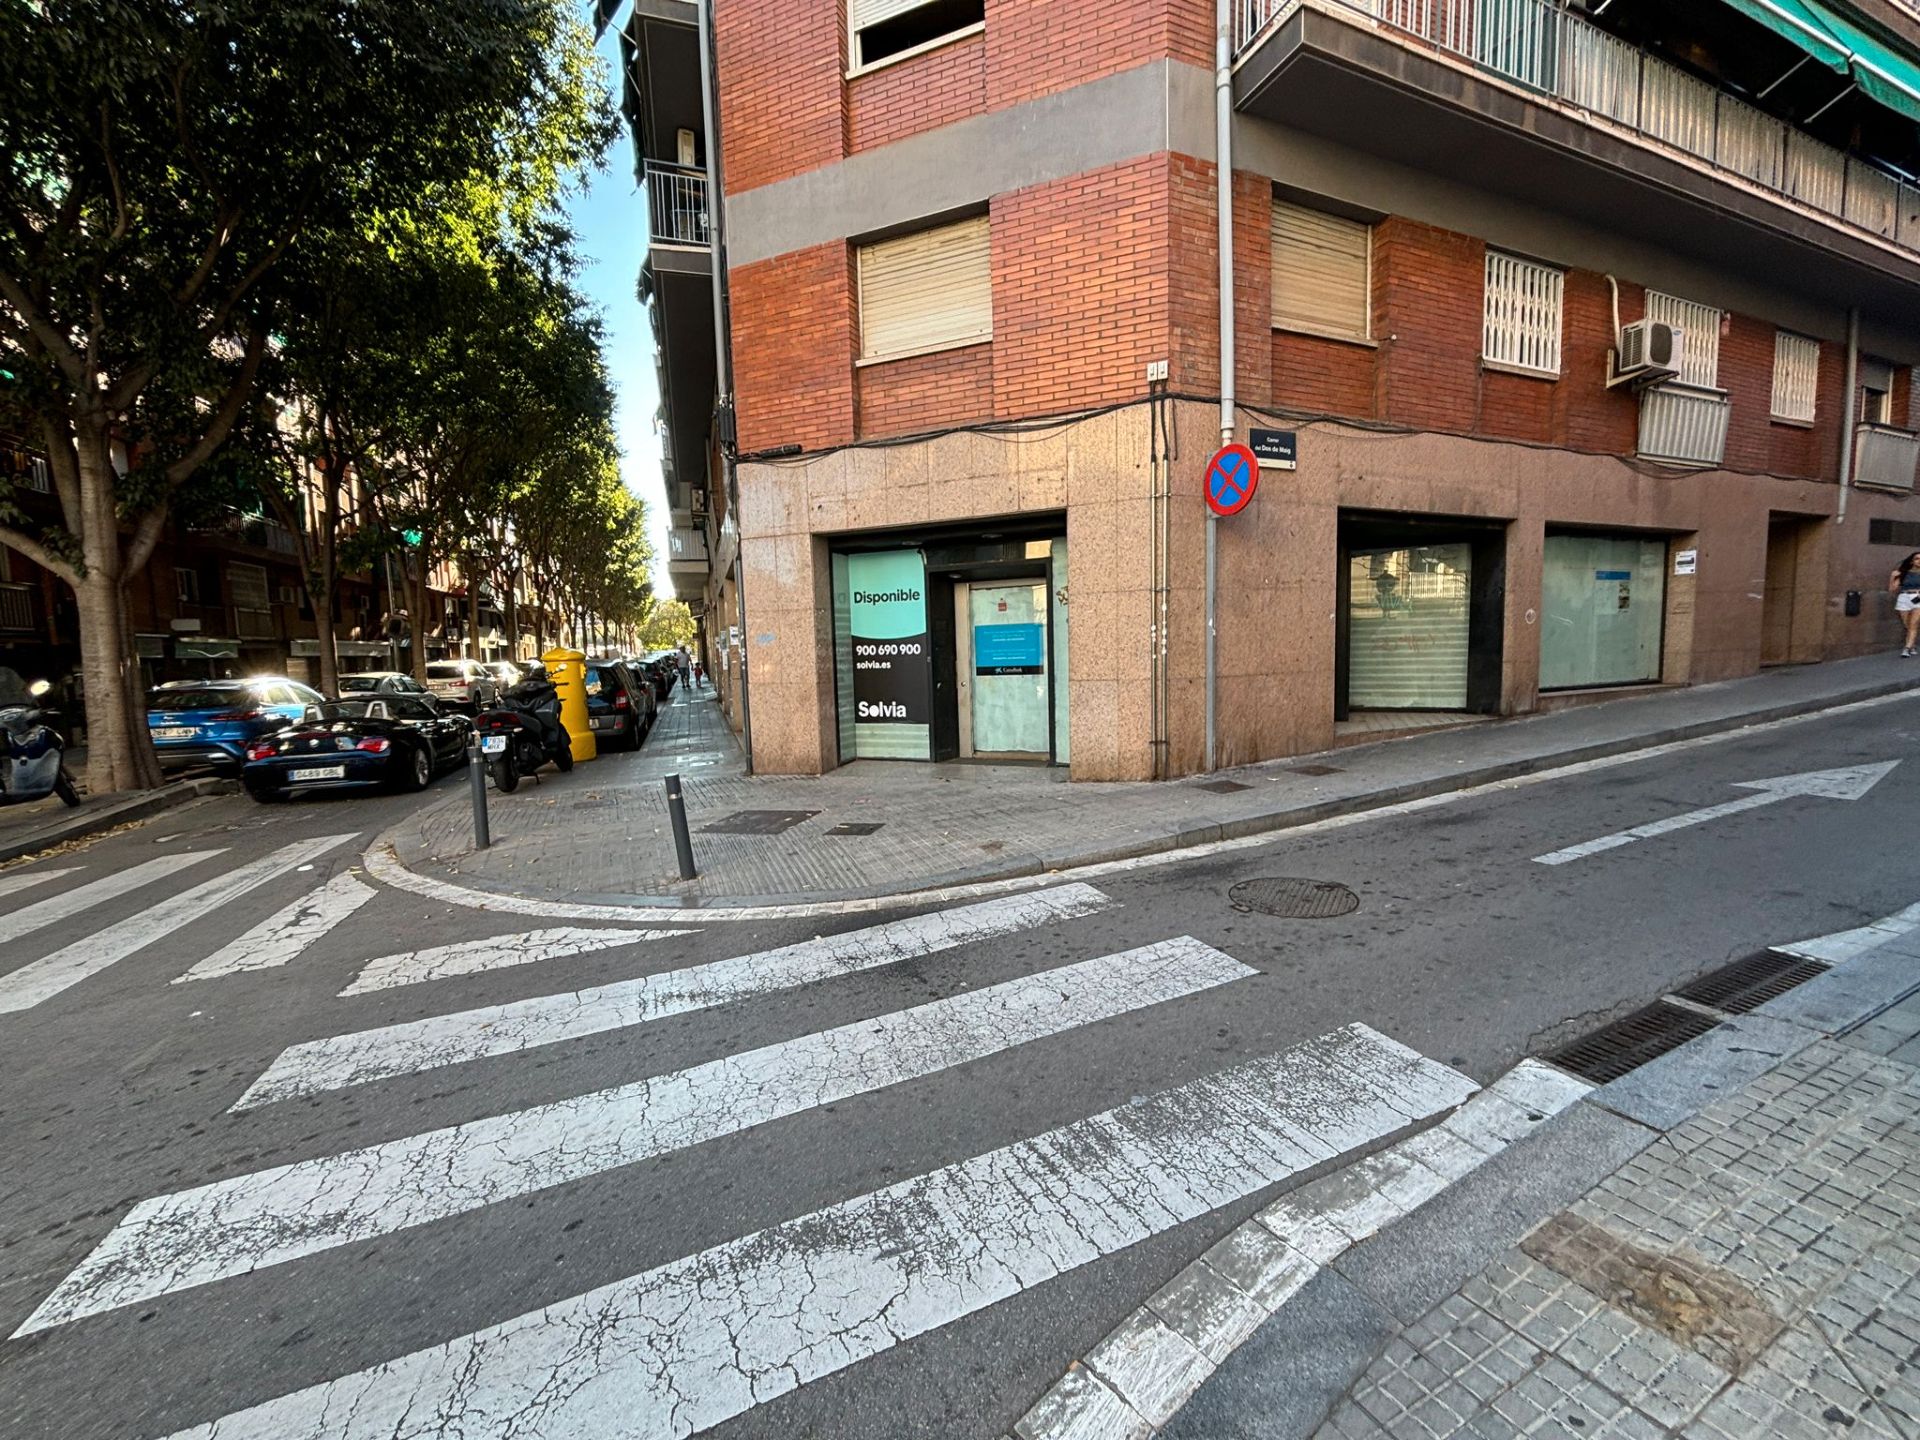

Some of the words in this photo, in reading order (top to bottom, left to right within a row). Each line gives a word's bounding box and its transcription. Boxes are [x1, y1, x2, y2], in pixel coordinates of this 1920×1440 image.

[1261, 444, 1272, 452] Dos
[853, 588, 921, 606] Disponible
[856, 644, 877, 656] 900
[878, 643, 898, 656] 690
[899, 643, 921, 655] 900
[856, 660, 892, 669] solvia.es
[858, 700, 907, 718] Solvia
